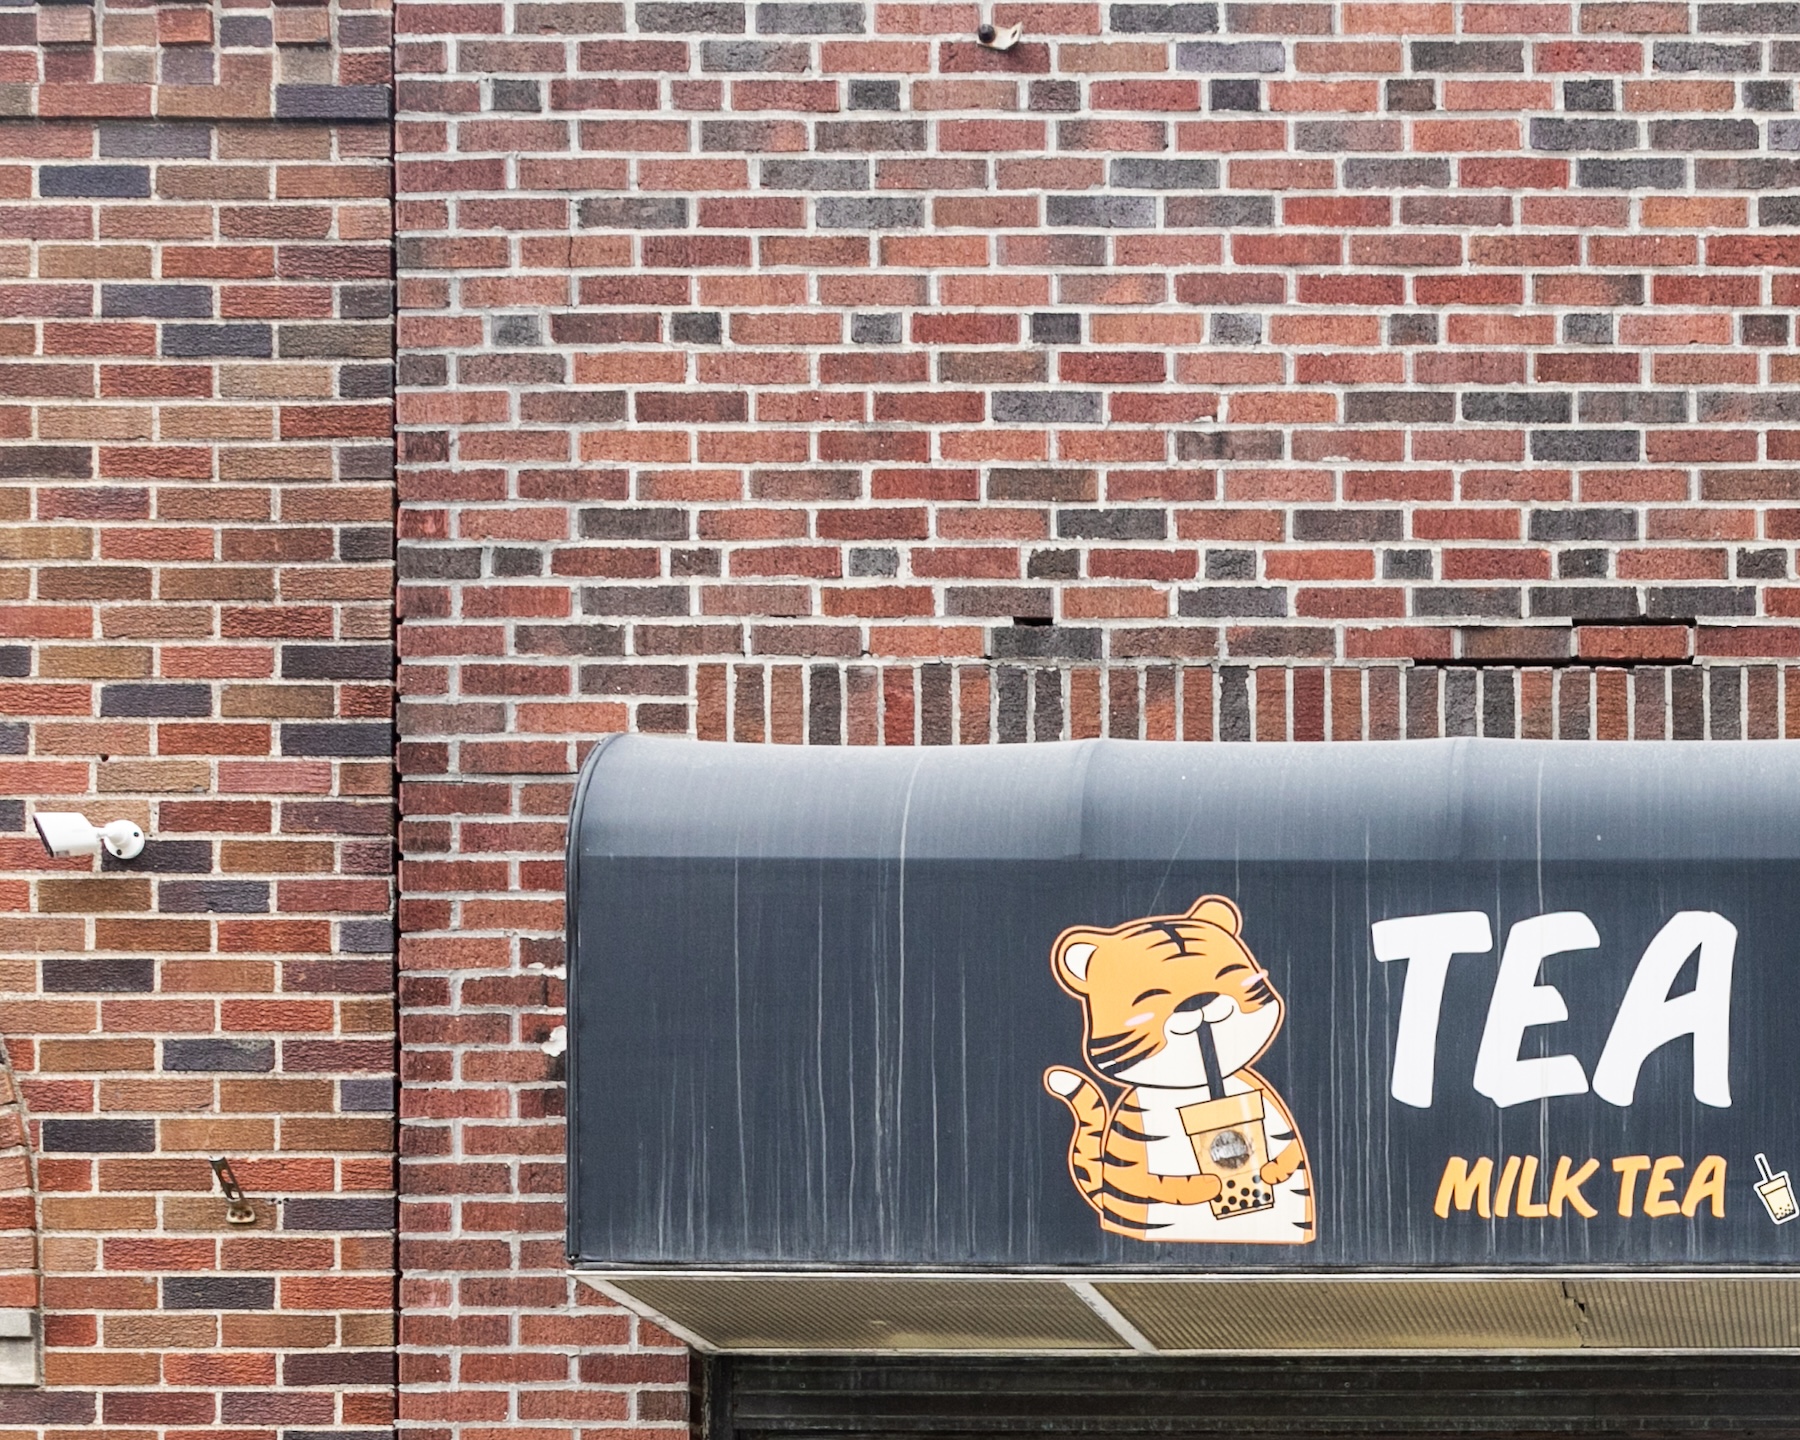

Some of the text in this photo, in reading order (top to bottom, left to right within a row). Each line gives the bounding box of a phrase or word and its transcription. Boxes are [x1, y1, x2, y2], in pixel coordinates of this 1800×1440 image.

[1373, 910, 1738, 1110] TEA
[1434, 1154, 1600, 1221] MILK
[1612, 1155, 1729, 1221] TEA
